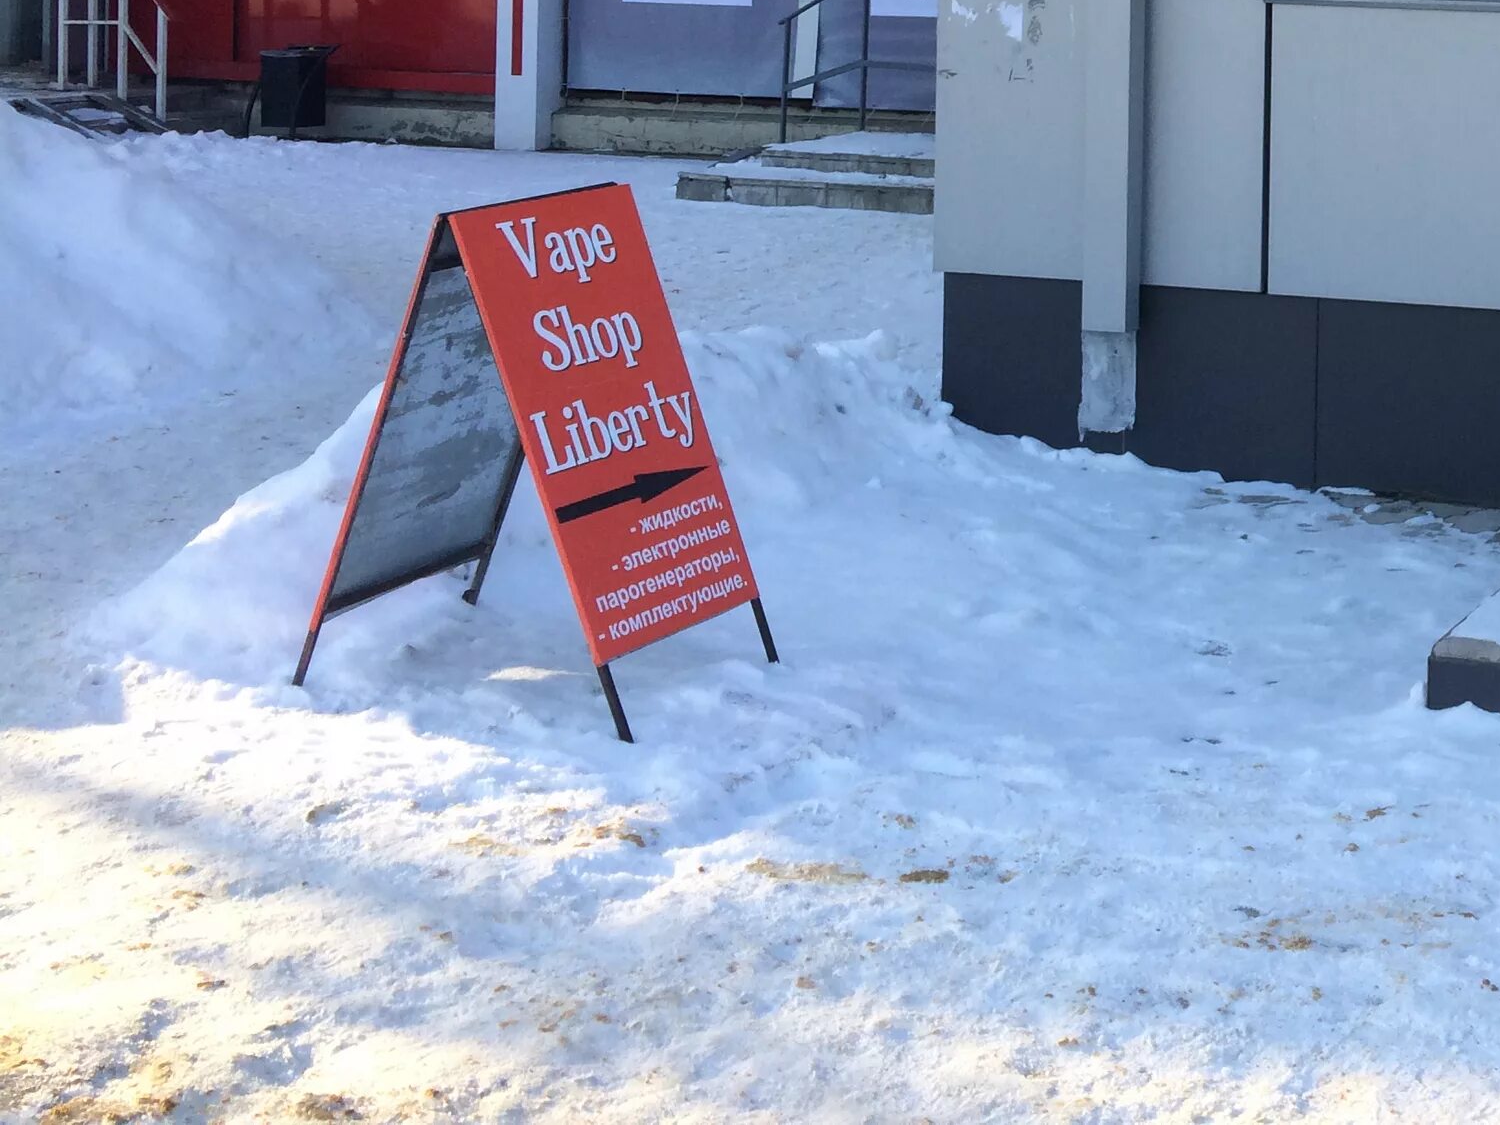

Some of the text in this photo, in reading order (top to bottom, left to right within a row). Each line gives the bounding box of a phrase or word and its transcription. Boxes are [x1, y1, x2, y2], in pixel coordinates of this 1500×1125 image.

[495, 216, 617, 284] Vape
[532, 305, 643, 371] Shop
[529, 380, 695, 475] Liberty
[621, 518, 731, 572] электронные
[638, 493, 724, 535] жидкости,
[595, 546, 740, 613] парогенераторы,
[608, 573, 748, 641] комплектующие.
